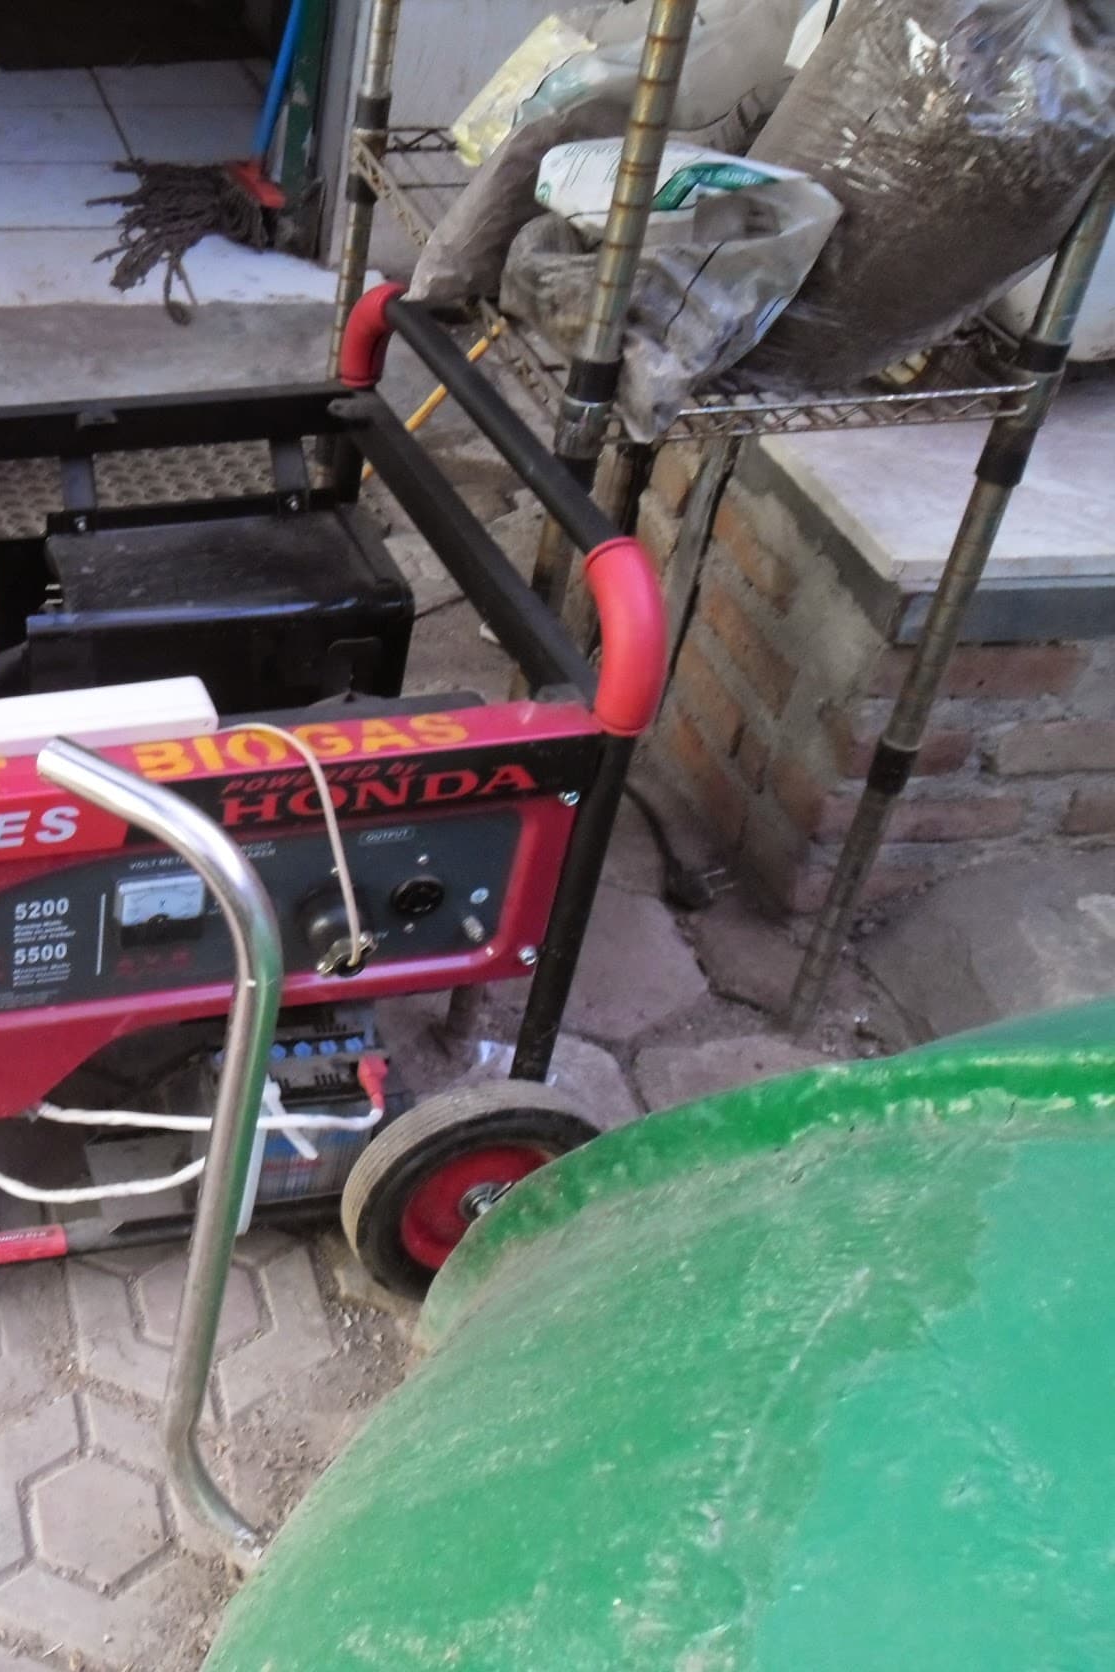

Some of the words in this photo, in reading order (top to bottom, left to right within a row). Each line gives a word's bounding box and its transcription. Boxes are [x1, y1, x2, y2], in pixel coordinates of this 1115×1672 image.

[132, 713, 469, 779] BIOGAS
[221, 762, 381, 794] POWERED
[221, 763, 539, 826] HONDA
[14, 897, 70, 921] 5200
[14, 943, 68, 966] 5500
